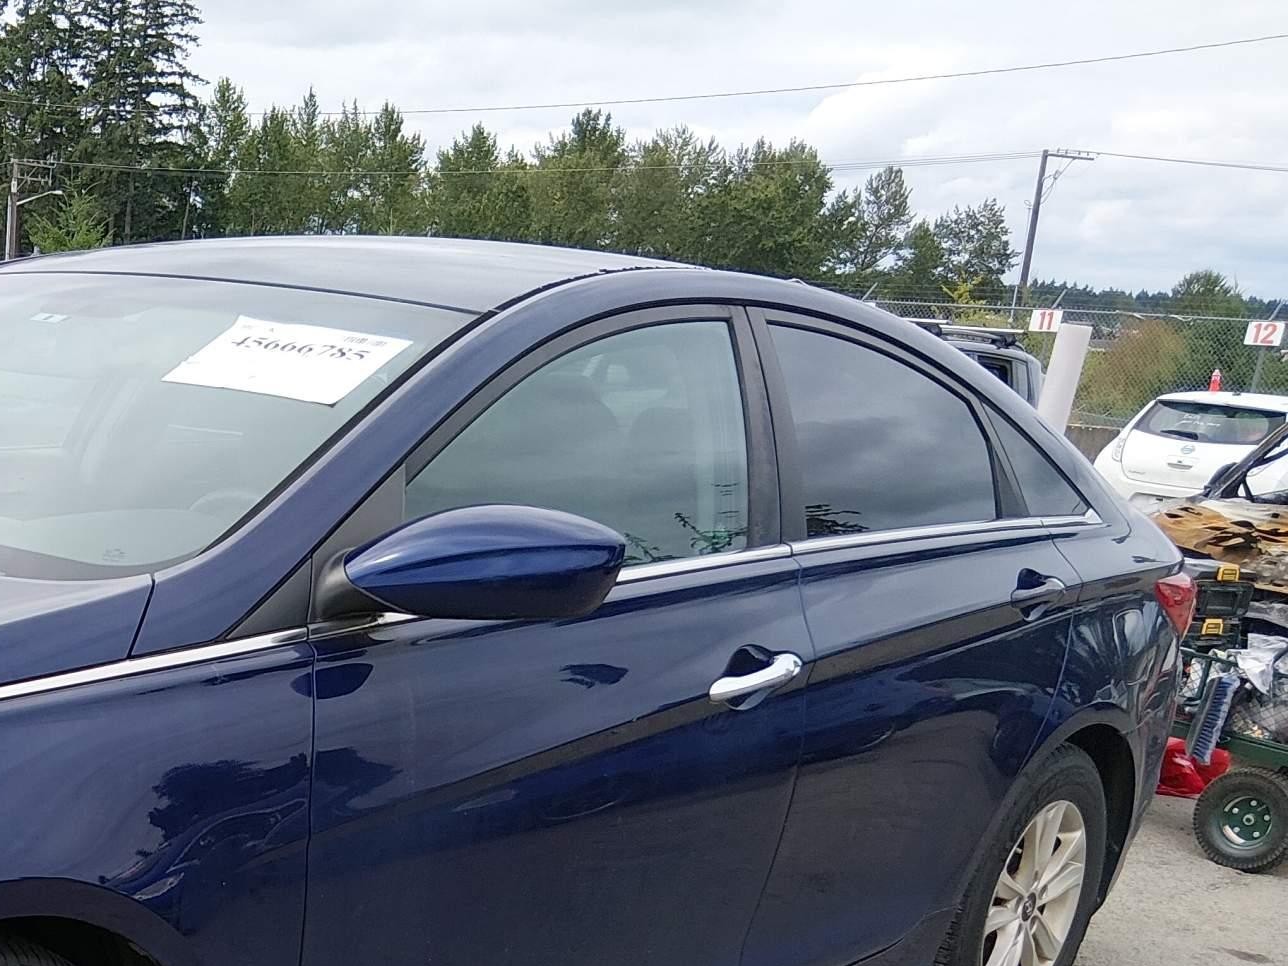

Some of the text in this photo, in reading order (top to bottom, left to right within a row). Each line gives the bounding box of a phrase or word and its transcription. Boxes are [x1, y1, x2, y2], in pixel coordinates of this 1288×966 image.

[1038, 311, 1055, 330] 11
[1252, 322, 1278, 344] 12
[231, 336, 371, 361] 45666785
